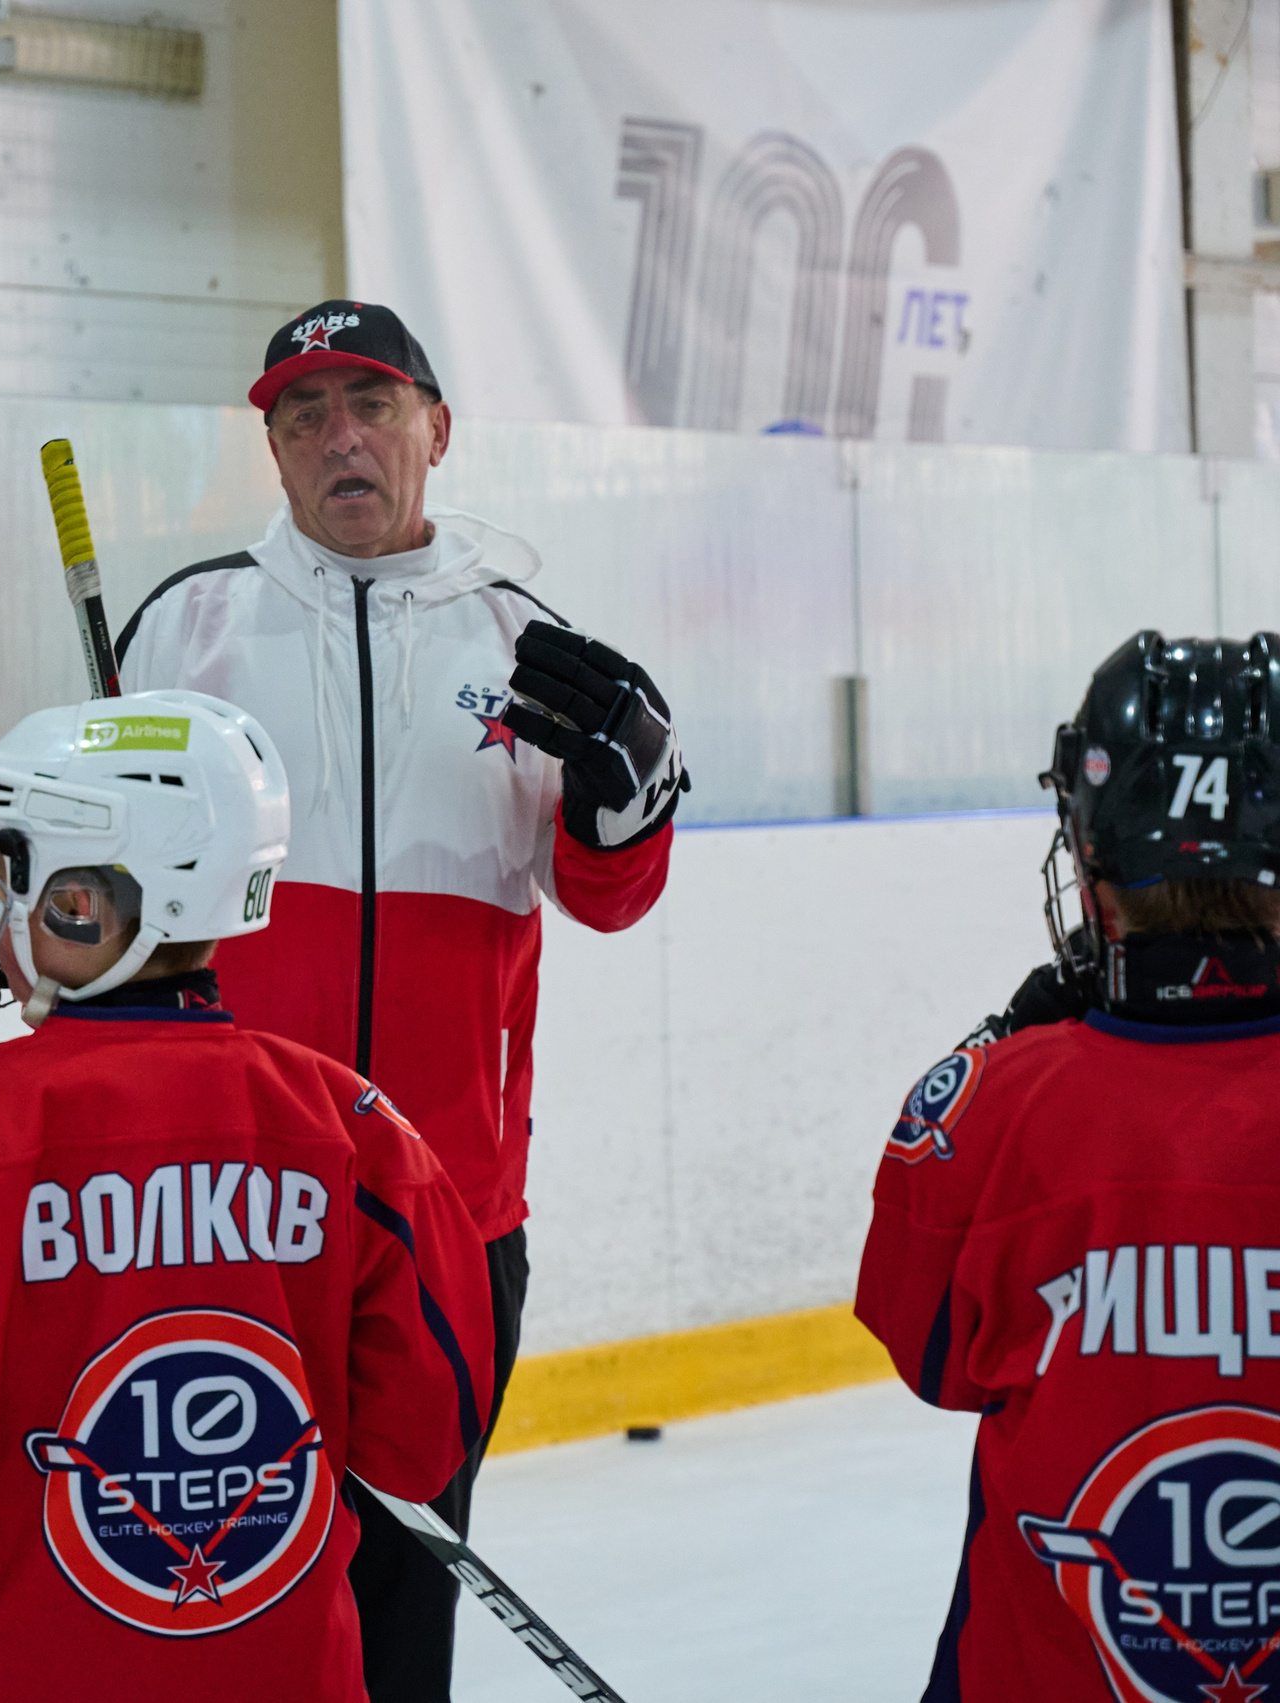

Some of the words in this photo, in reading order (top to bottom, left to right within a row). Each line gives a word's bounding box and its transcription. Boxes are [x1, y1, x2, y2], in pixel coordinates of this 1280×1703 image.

[122, 724, 182, 740] Airlines
[1168, 753, 1230, 821] 74
[243, 867, 272, 923] 80
[23, 1162, 328, 1283] ВОЛКОВ
[131, 1375, 257, 1458] 10
[98, 1462, 295, 1515] STEPS
[99, 1525, 144, 1537] ELITE
[149, 1521, 214, 1535] HOCKEY
[218, 1512, 288, 1530] TRAINING
[1158, 1480, 1280, 1569] 10
